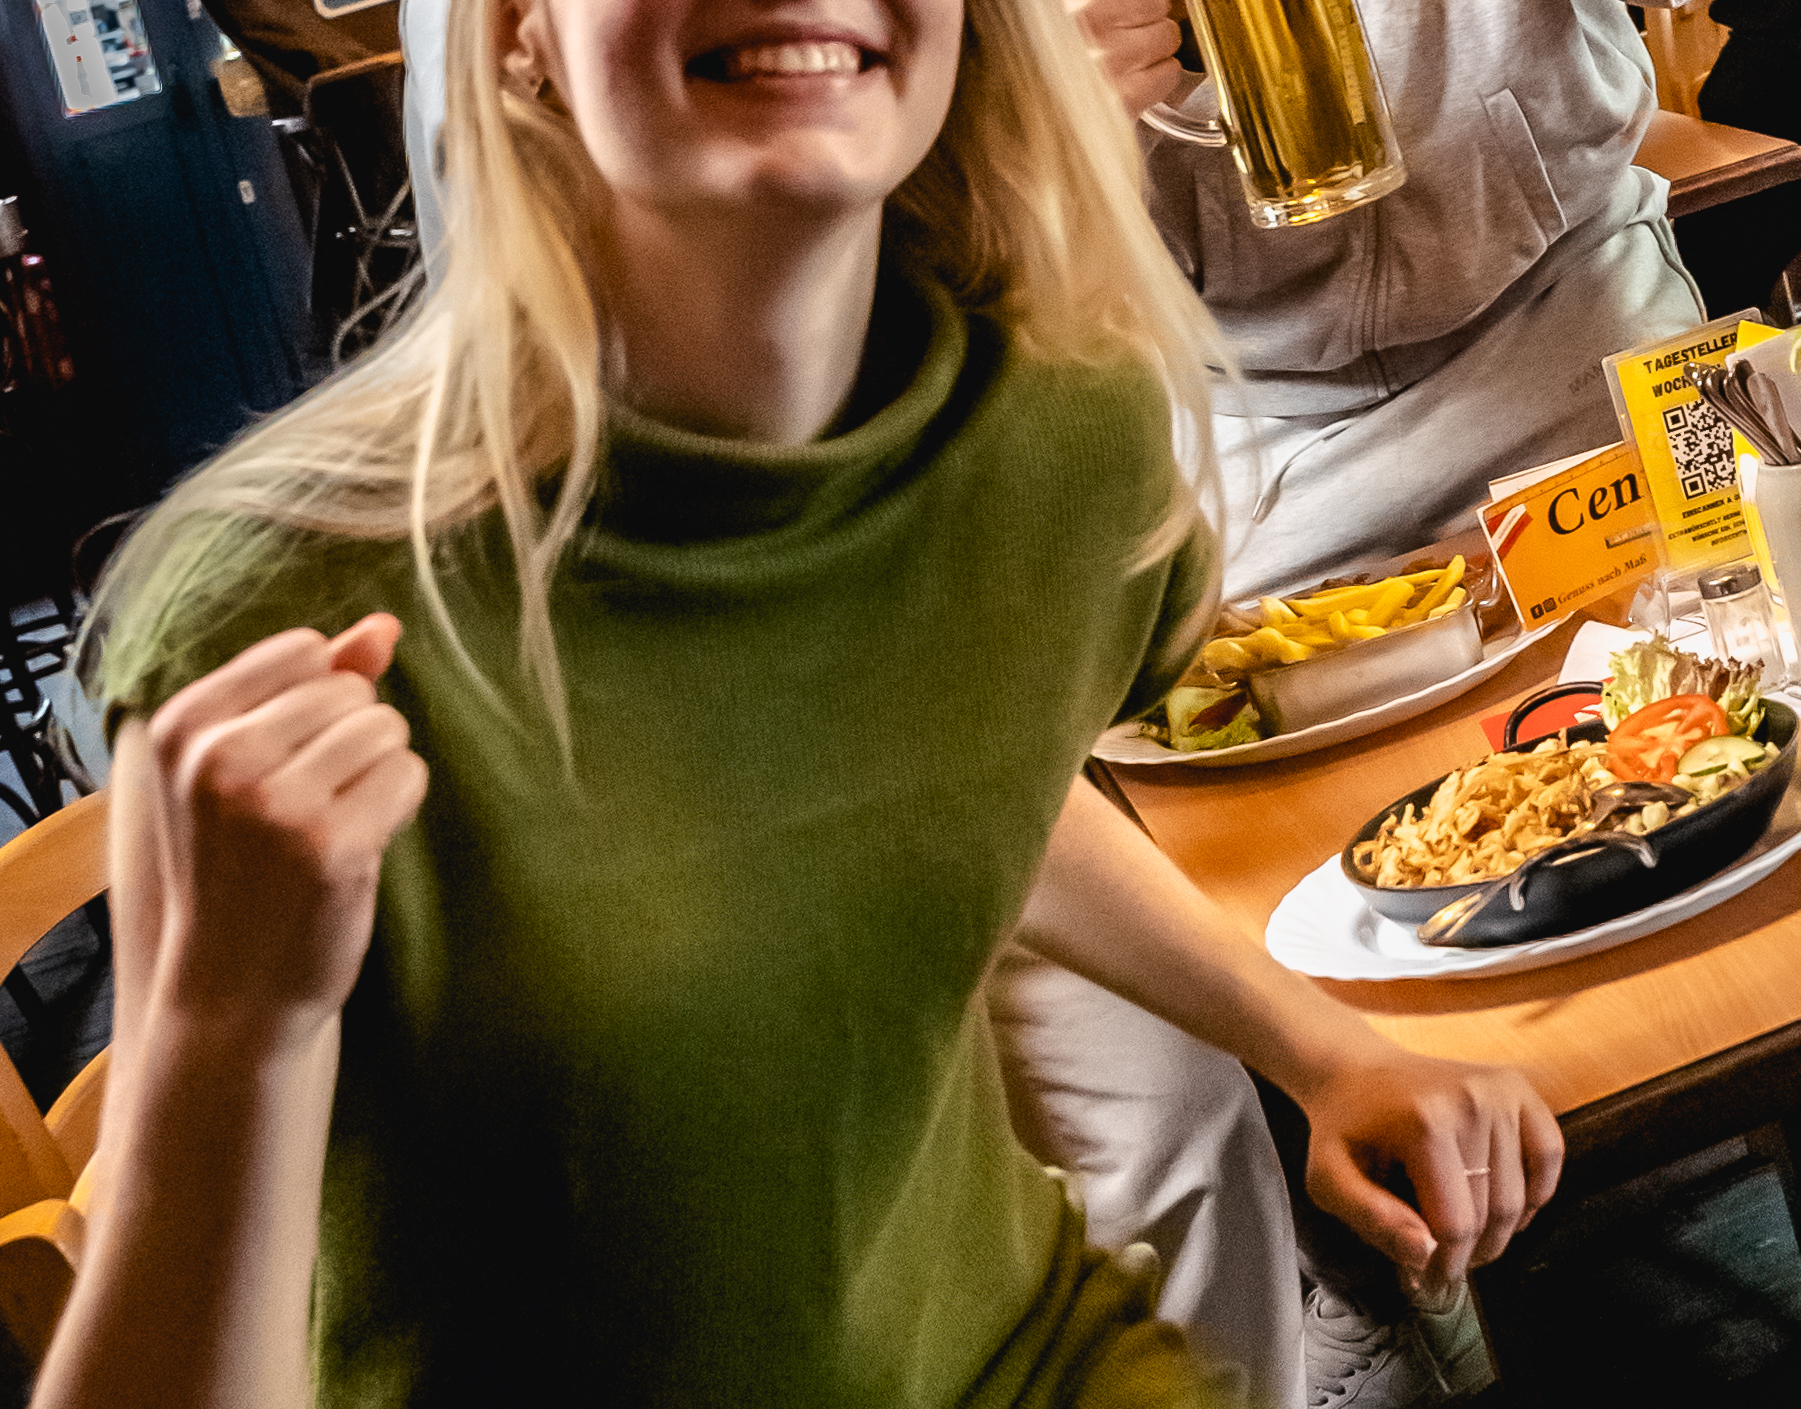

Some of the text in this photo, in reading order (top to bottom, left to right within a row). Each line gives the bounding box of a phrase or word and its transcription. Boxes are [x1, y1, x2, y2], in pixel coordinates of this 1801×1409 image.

[1547, 472, 1644, 536] Cen
[1557, 581, 1595, 605] Genuss
[1597, 565, 1622, 586] nach
